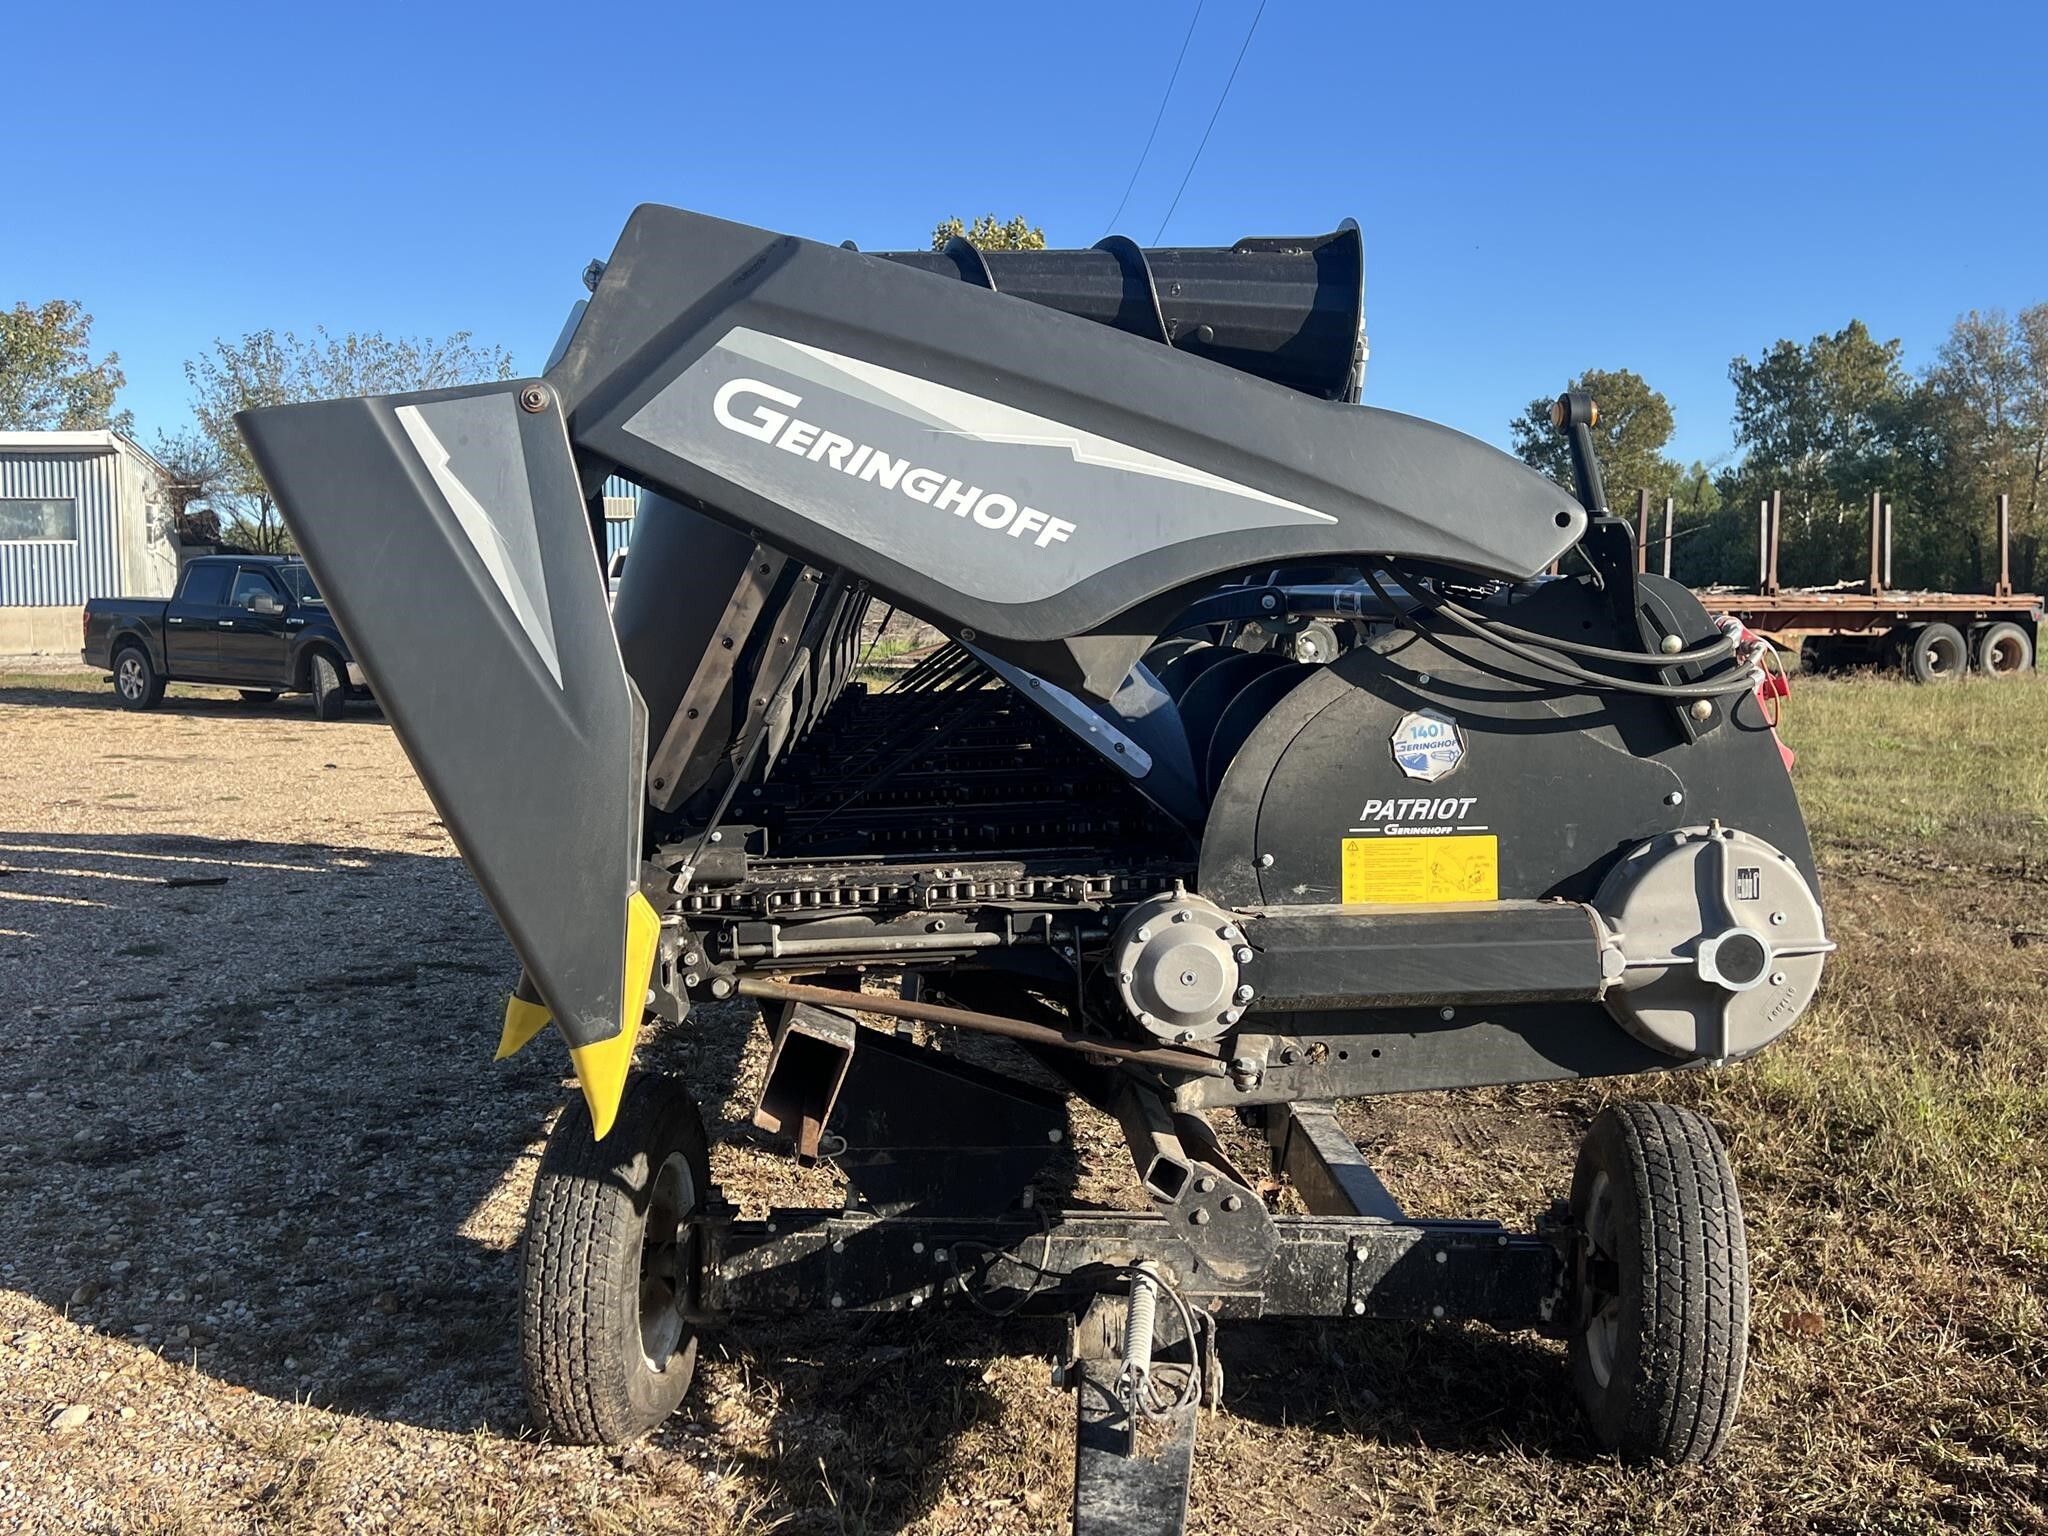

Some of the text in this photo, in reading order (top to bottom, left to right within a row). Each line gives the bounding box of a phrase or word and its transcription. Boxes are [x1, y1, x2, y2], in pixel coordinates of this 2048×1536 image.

[712, 378, 1077, 548] GERINGHOFF
[1410, 723, 1439, 740] 140
[1395, 739, 1458, 753] GERINGHOF
[1359, 797, 1478, 821] PATRIOT
[1383, 823, 1453, 836] GERINGHOFF
